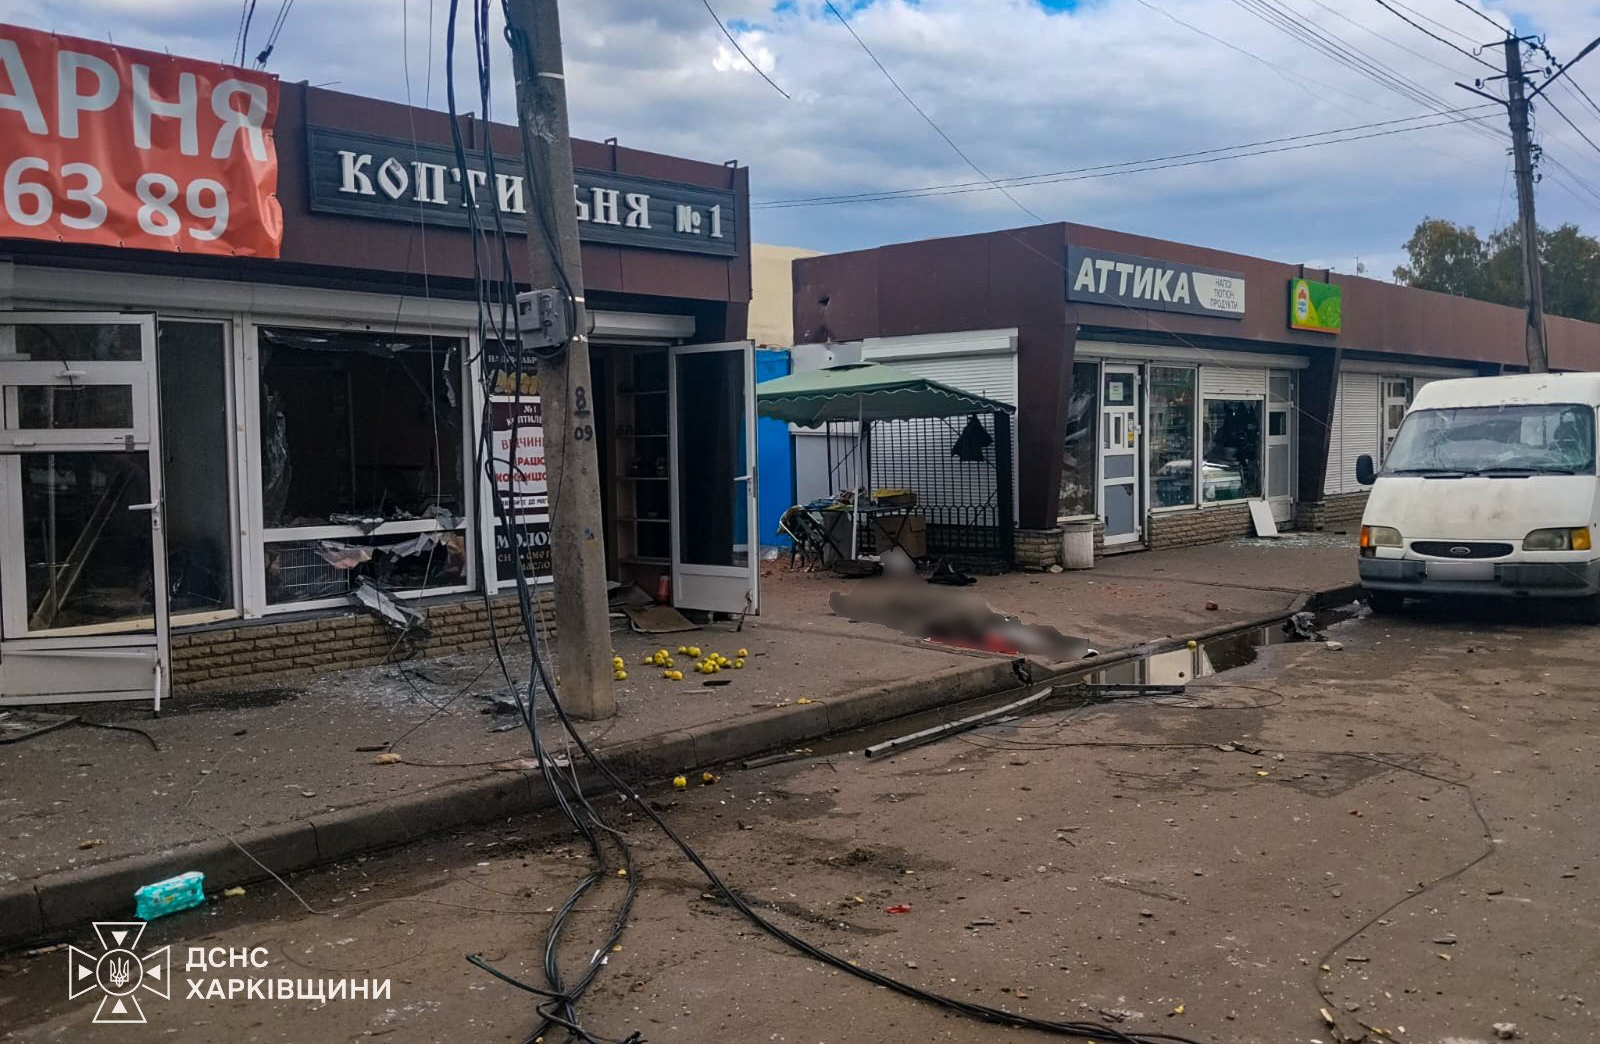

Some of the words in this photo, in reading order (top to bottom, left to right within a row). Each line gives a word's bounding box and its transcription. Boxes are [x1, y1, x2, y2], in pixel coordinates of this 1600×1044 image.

[0, 38, 269, 162] АРНЯ
[4, 156, 108, 230] 63
[135, 172, 230, 241] 89
[337, 150, 652, 229] КОПТИЬНЯ
[1073, 256, 1191, 305] АТТИКА
[574, 424, 593, 441] 09
